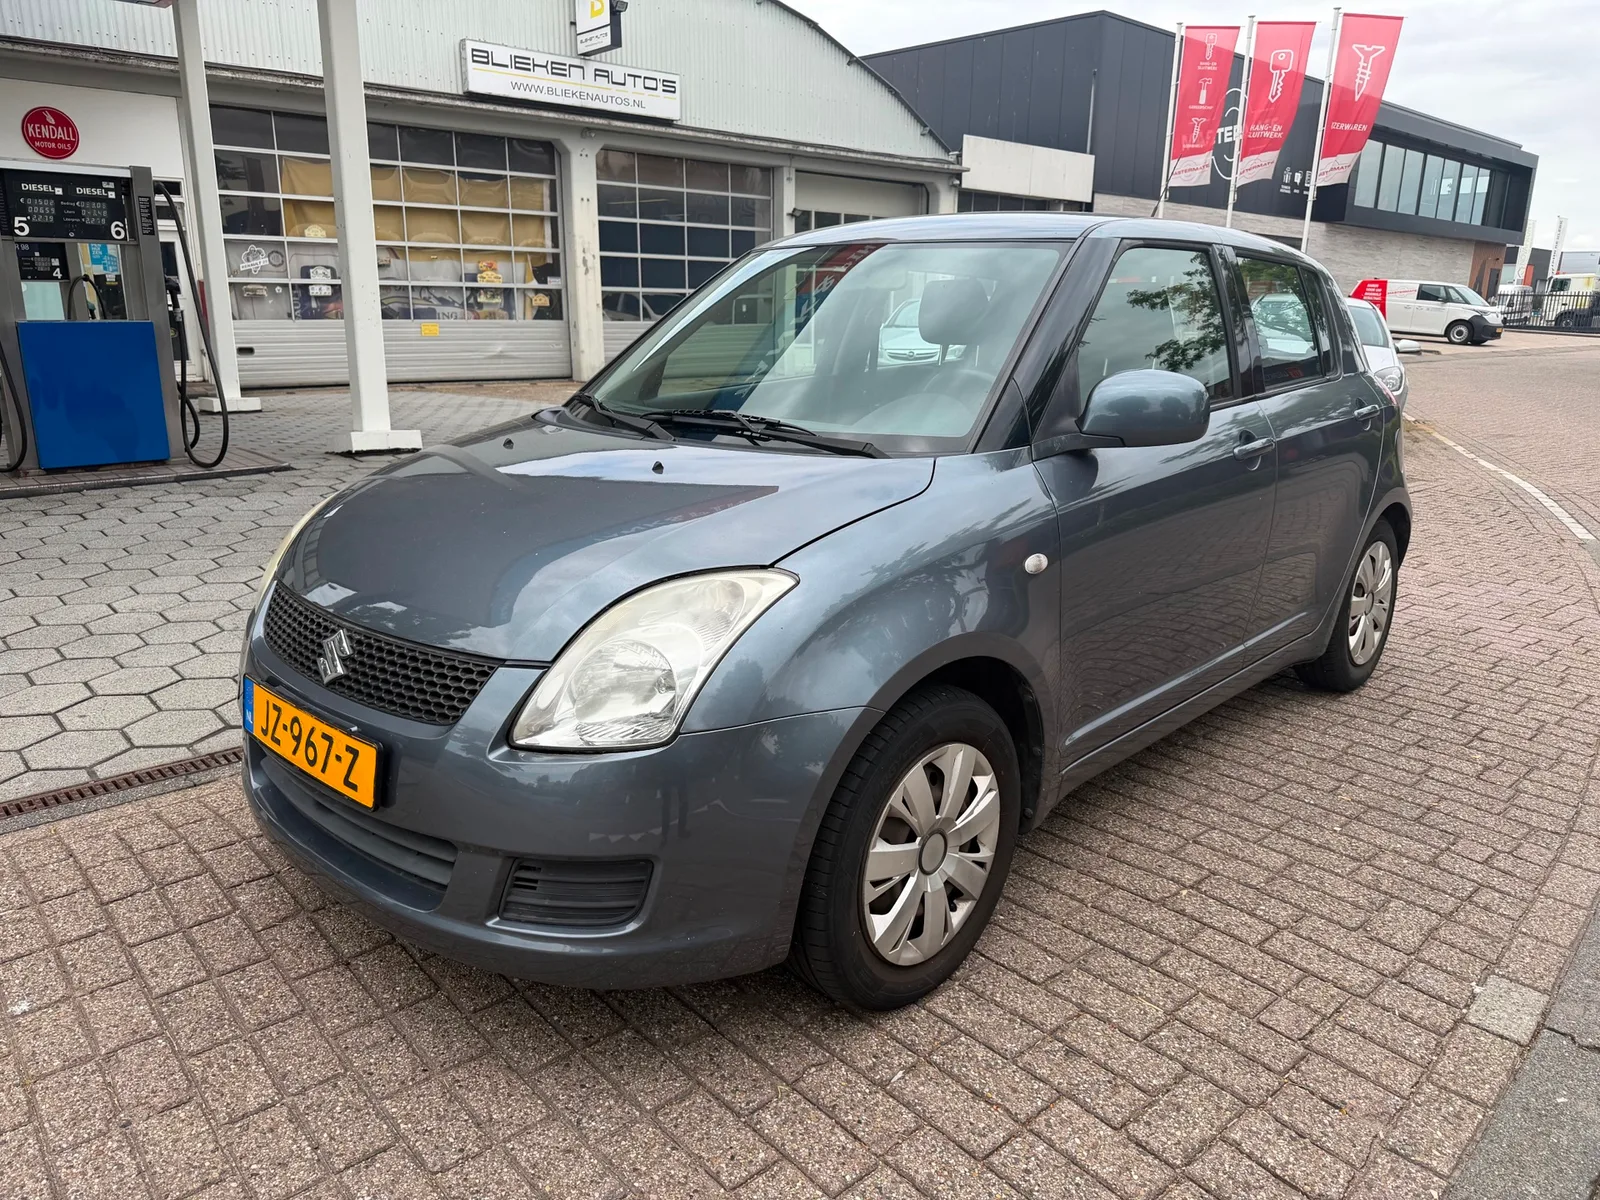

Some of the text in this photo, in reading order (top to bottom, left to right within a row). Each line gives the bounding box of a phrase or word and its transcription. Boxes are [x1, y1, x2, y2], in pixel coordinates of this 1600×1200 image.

[471, 48, 677, 94] BLIEKEN AUTO'S
[510, 81, 646, 109] WWW.BLIEKENAUTOS.NL
[27, 123, 76, 141] KENDALL
[34, 141, 72, 151] MOTOR OILS
[21, 183, 54, 192] DIESEL
[76, 187, 108, 196] DIESEL
[13, 216, 30, 237] 5
[110, 221, 126, 240] 6
[52, 267, 63, 279] 4
[245, 708, 253, 724] NL
[260, 699, 360, 793] JZ-967-Z
